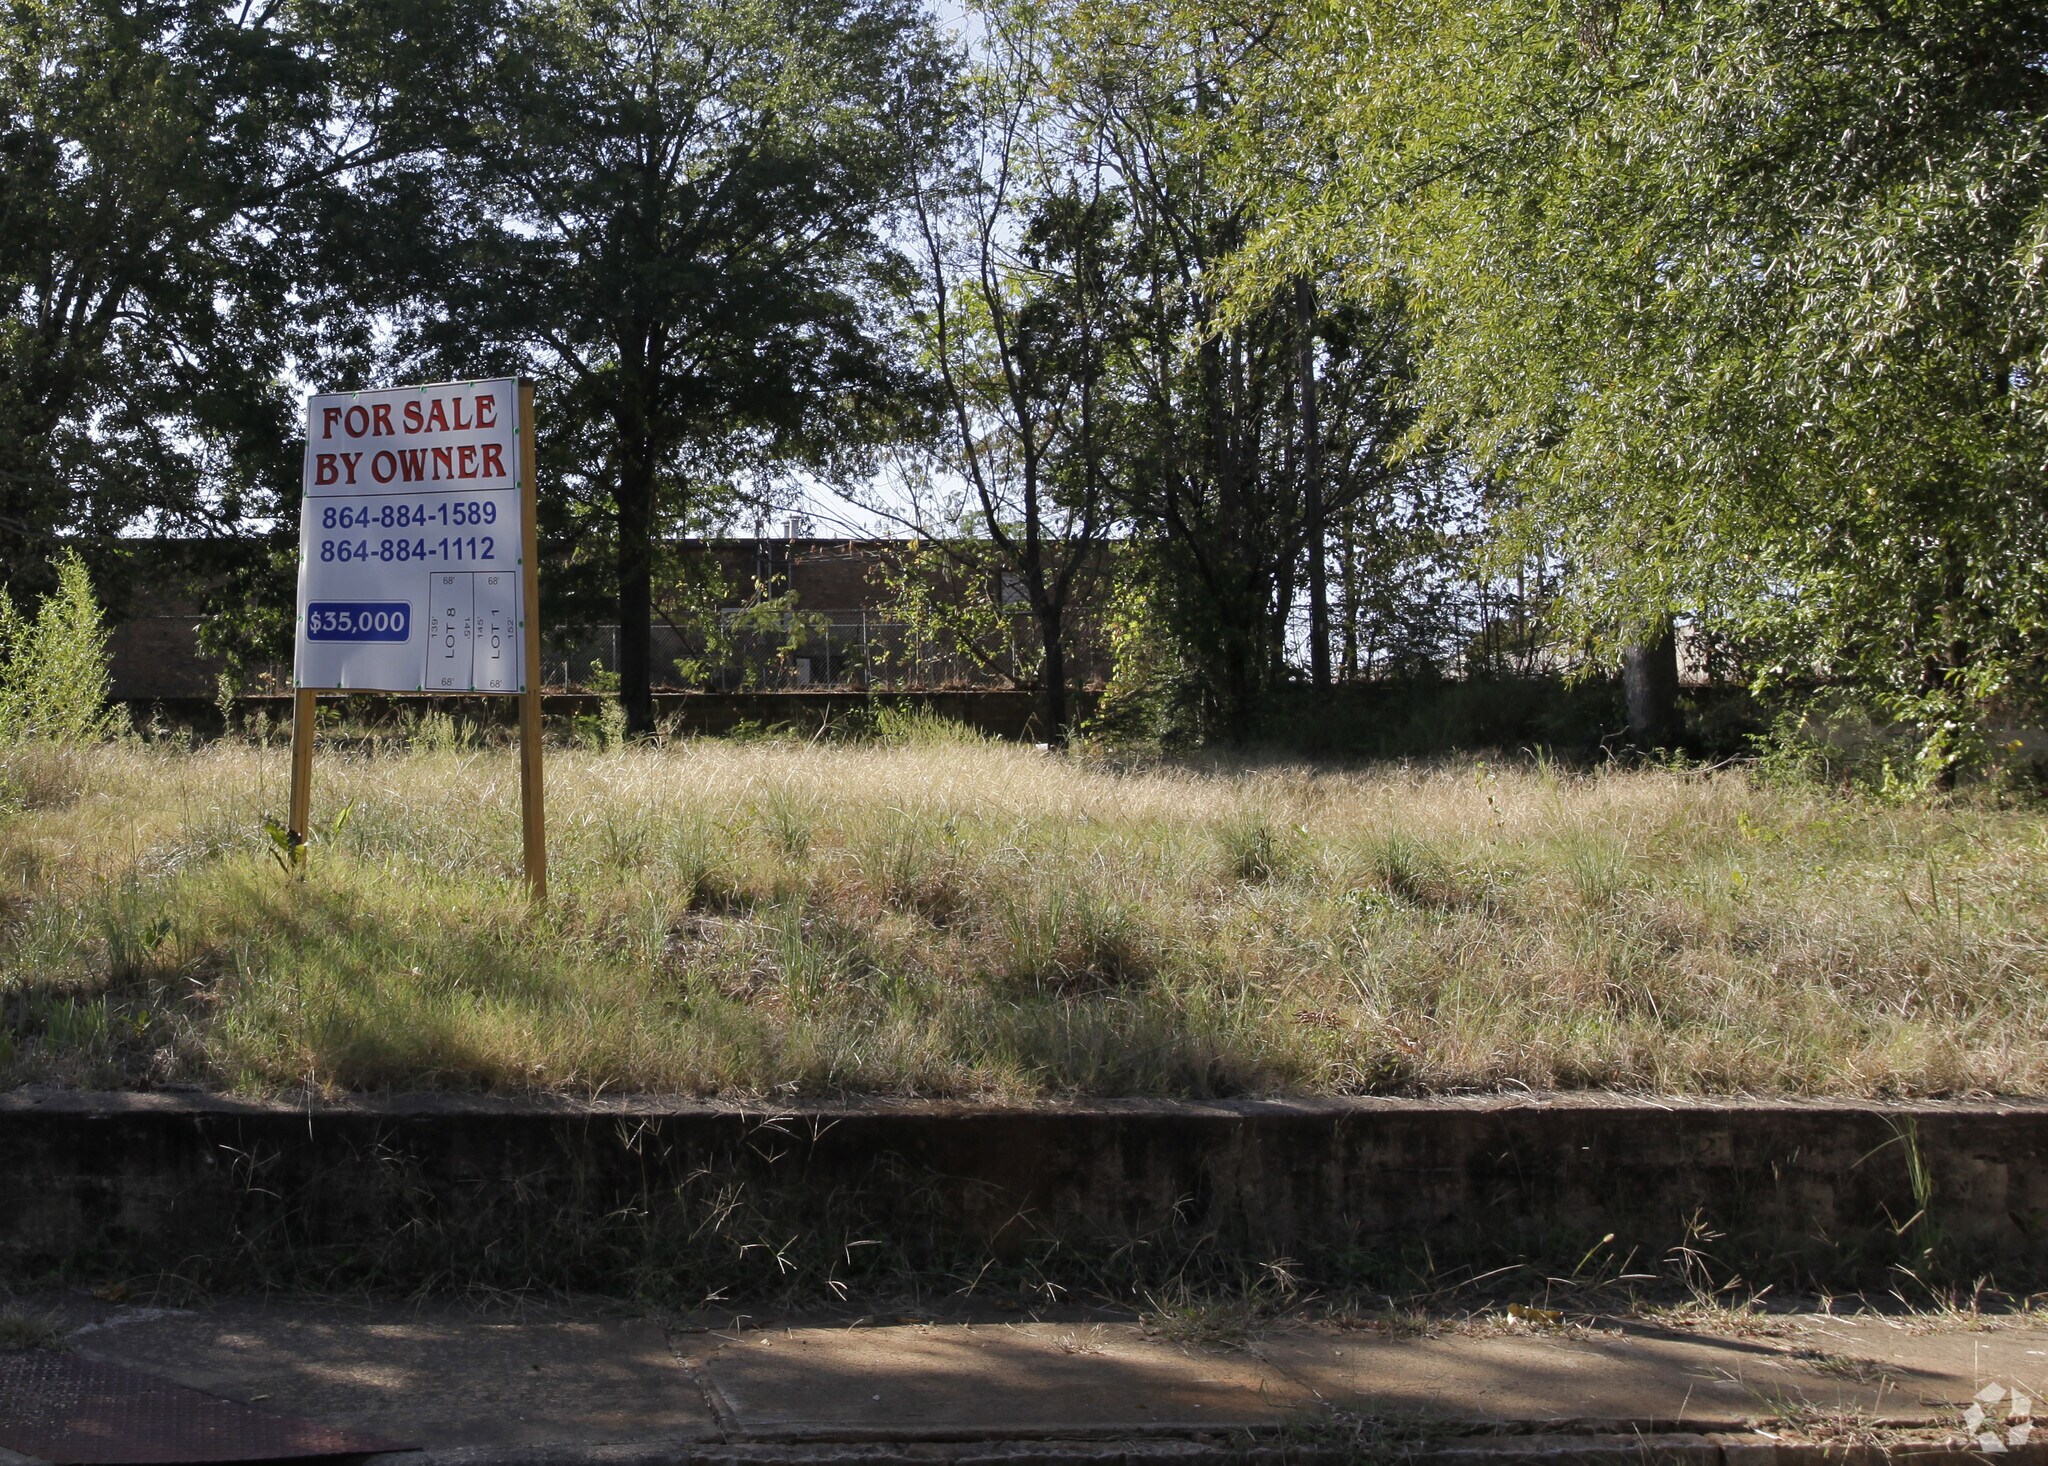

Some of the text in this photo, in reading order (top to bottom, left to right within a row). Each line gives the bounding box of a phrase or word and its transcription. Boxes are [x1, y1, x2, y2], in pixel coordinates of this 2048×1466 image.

[322, 395, 497, 439] FOR SALE
[314, 443, 507, 485] BY OWNER
[322, 501, 497, 529] 864-884-1589
[320, 536, 495, 563] 864-884-1112
[442, 576, 456, 586] 68'
[487, 576, 500, 586] 68'
[309, 611, 405, 634] $35,000
[445, 607, 456, 659] LOT 8
[491, 608, 501, 660] LOT 1
[441, 677, 455, 687] 68'
[489, 679, 503, 689] 68'
